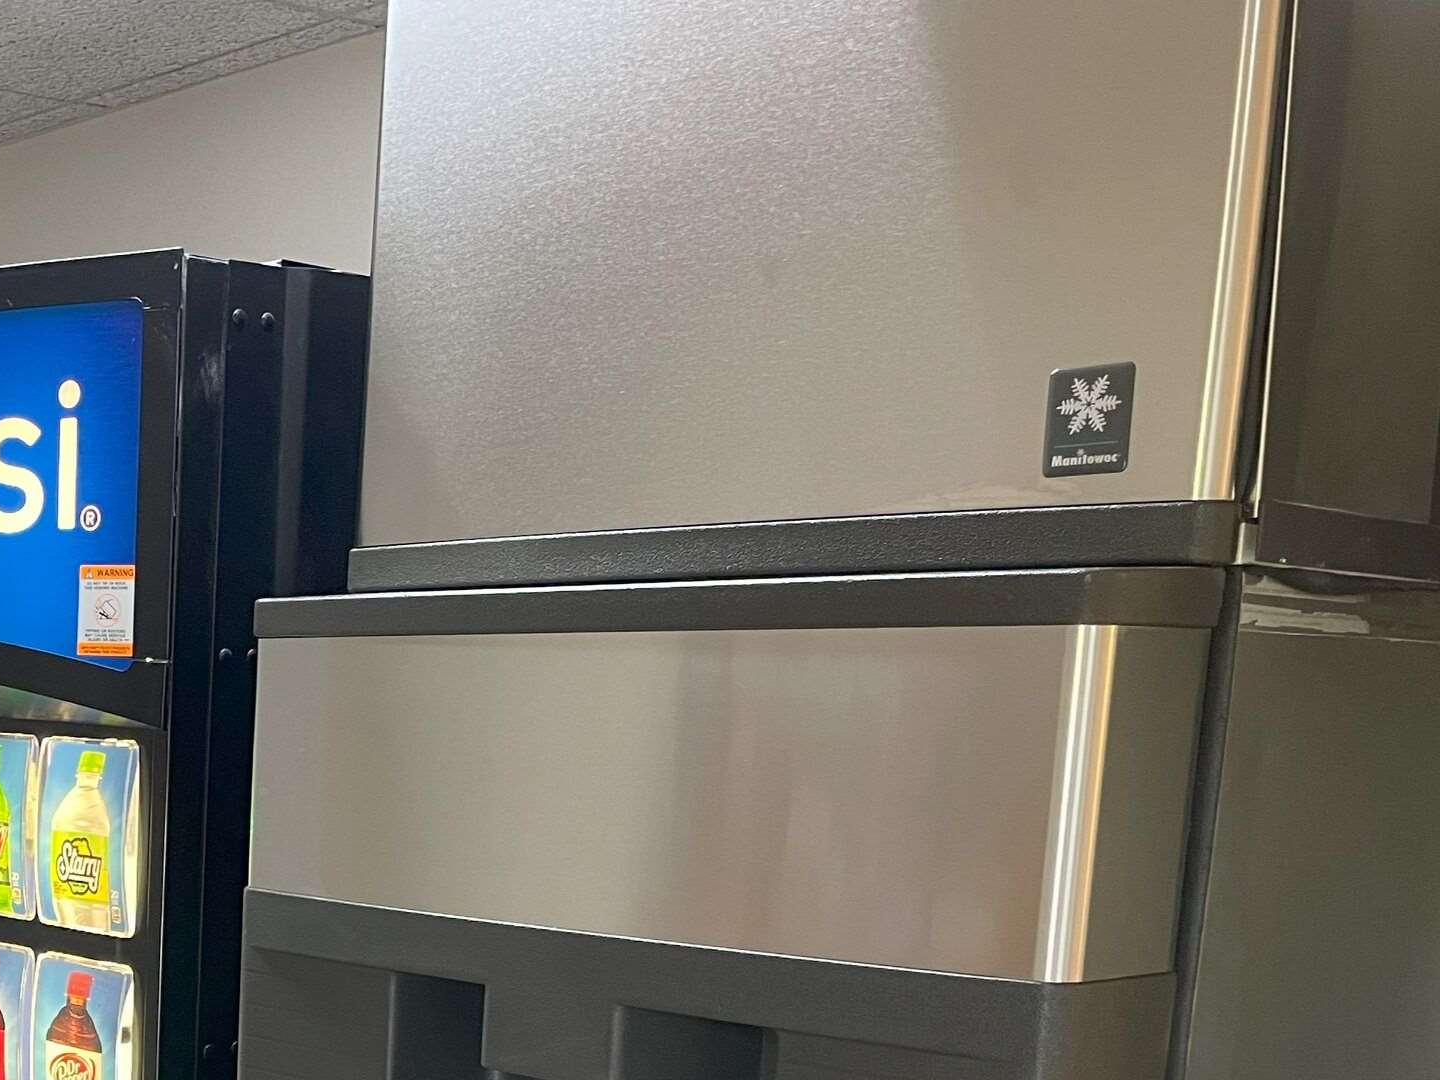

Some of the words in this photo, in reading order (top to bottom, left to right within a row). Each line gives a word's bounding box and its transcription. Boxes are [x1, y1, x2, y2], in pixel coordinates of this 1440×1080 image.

[1051, 453, 1119, 467] Manitowoc
[96, 568, 134, 577] WARNING
[57, 840, 101, 893] Starry
